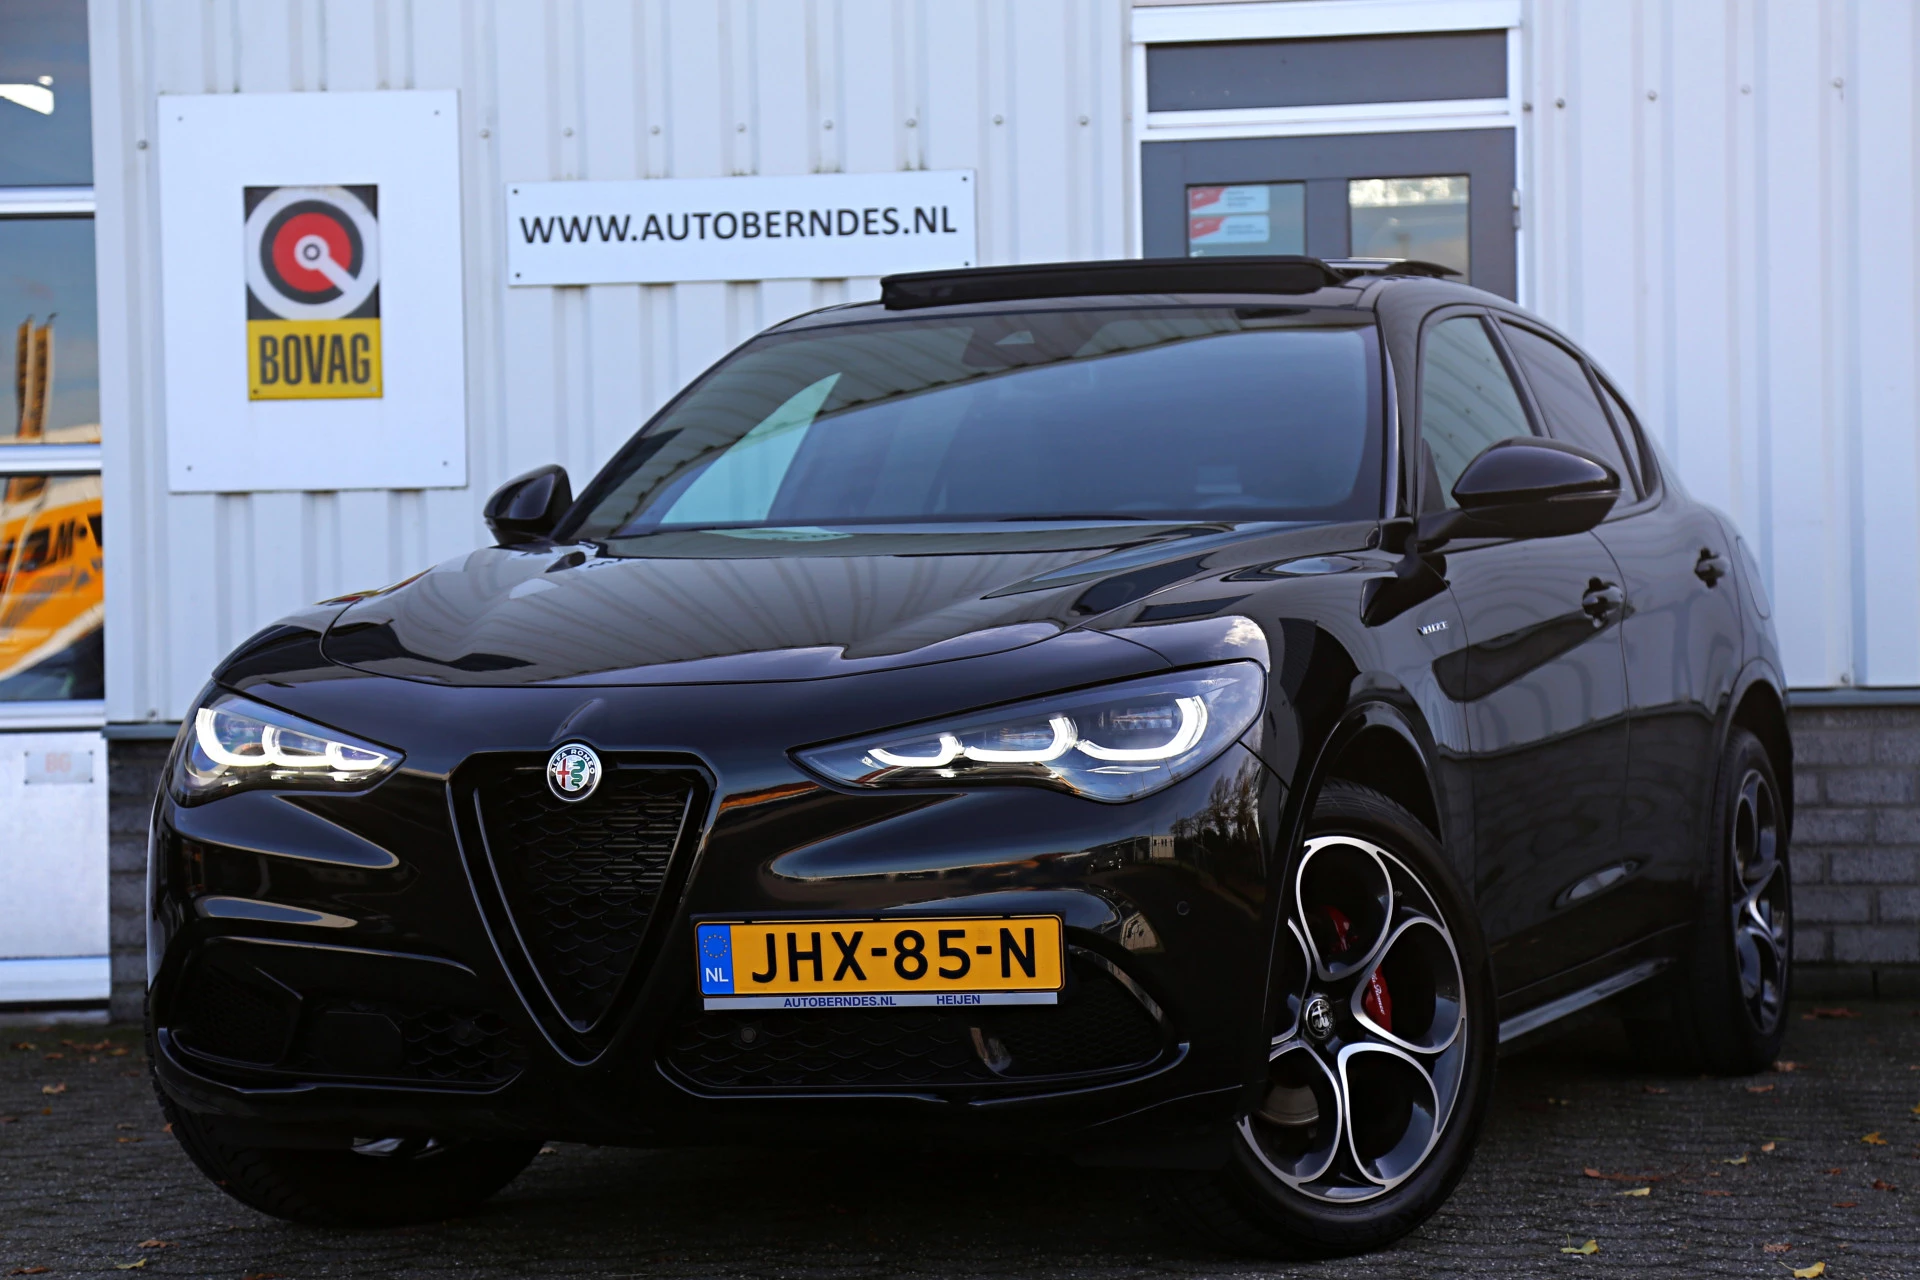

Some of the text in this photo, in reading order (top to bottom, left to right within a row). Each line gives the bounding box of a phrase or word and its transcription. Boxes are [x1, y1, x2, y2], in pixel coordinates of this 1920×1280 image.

[519, 206, 958, 244] WWW.AUTOBERNDES.NL
[259, 332, 371, 385] BOVAG
[551, 749, 595, 774] ALFA ROMEO
[752, 927, 1037, 983] JHX-85-N
[705, 968, 729, 983] NL
[784, 995, 981, 1008] AUTOBERNDES.NL HEIJEN
